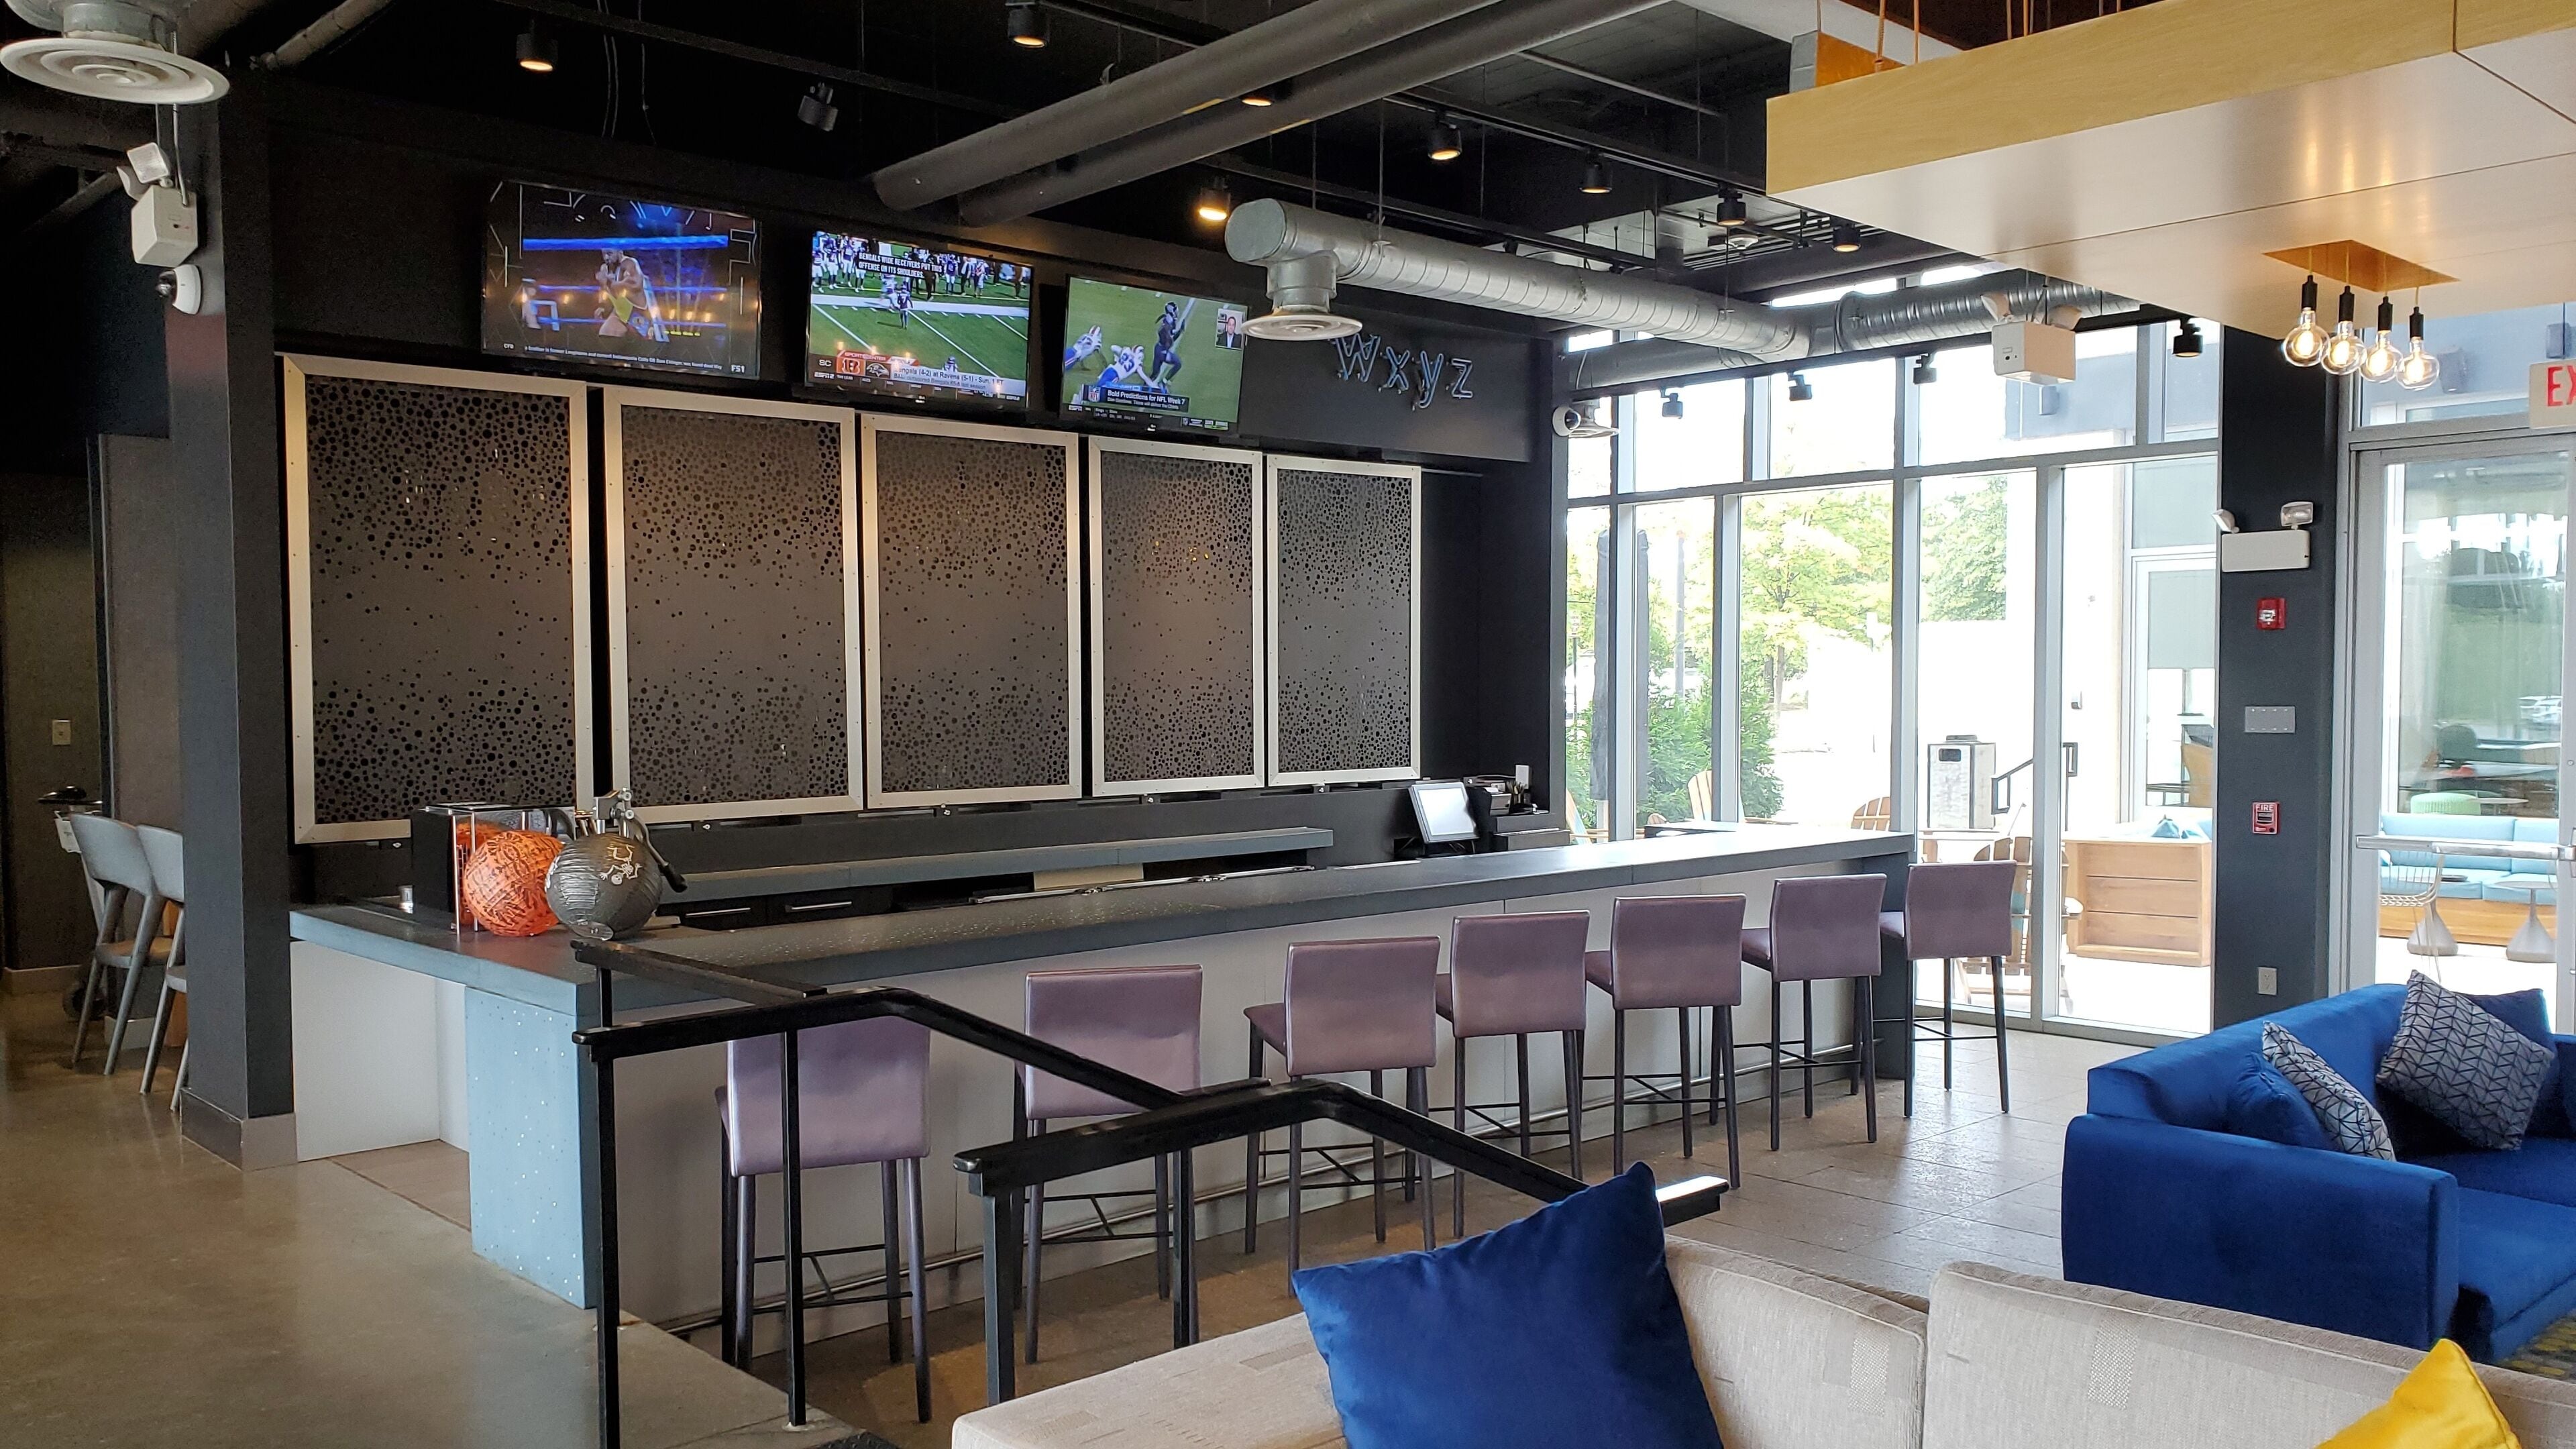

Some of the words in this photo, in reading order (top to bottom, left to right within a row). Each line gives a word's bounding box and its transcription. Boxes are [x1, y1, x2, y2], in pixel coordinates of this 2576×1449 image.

[859, 252, 881, 262] BENGALS
[881, 255, 894, 265] WIDE
[894, 258, 920, 269] RECEIVERS
[921, 262, 930, 271] PUT
[931, 264, 943, 273] THIS
[859, 261, 880, 272] OFFENSE
[880, 264, 888, 273] ON
[888, 266, 896, 274] ITS
[731, 364, 745, 374] FS1
[818, 359, 832, 367] SC
[894, 366, 918, 376] engals
[918, 368, 932, 378] (4-2)
[939, 371, 961, 381] Ravens
[961, 374, 974, 382] (5-1)
[1108, 389, 1120, 397] Bold
[1120, 391, 1148, 400] Predictions
[1148, 394, 1157, 402] for
[1157, 395, 1167, 403] NFL
[1167, 396, 1181, 405] Week
